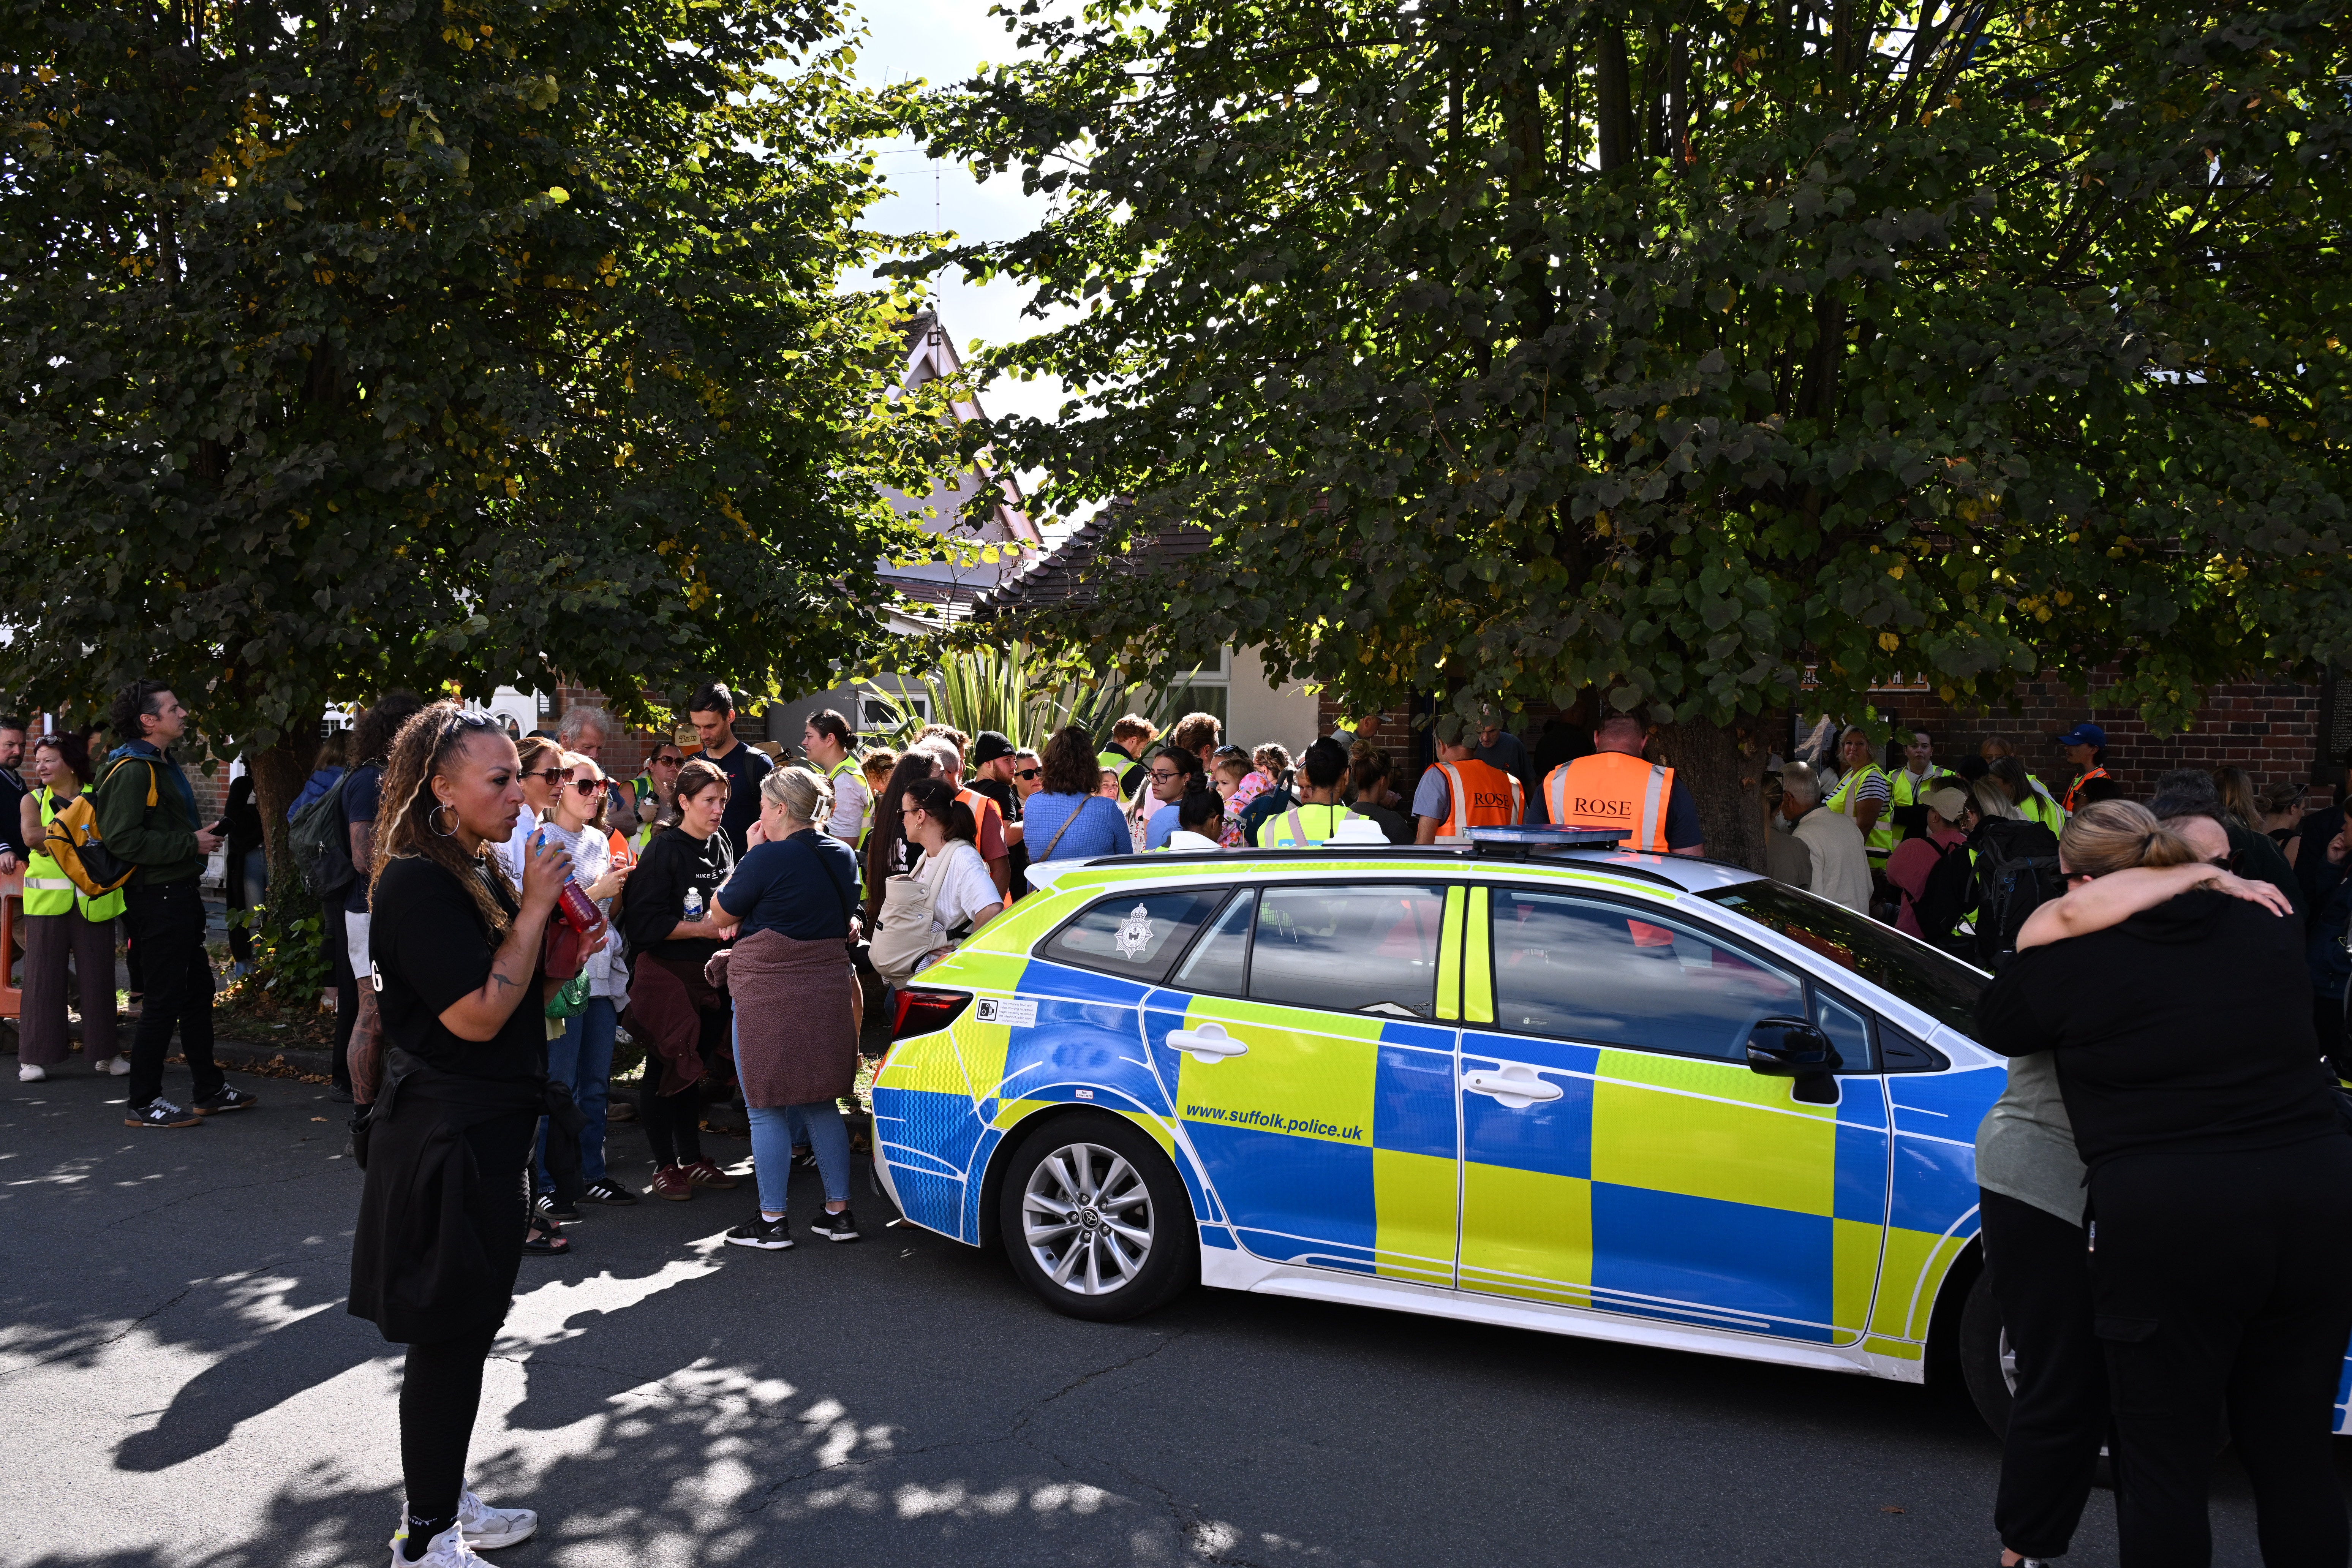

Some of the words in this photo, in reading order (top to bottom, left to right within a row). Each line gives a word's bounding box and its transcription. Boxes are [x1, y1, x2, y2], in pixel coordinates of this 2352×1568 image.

[1893, 670, 1924, 683] HL
[1474, 792, 1509, 807] ROSE
[1574, 798, 1631, 815] ROSE
[1122, 934, 1145, 947] CONSTABULARY
[226, 1092, 237, 1100] N
[150, 1109, 166, 1119] N
[1187, 1105, 1363, 1140] www.suffolk.police.uk
